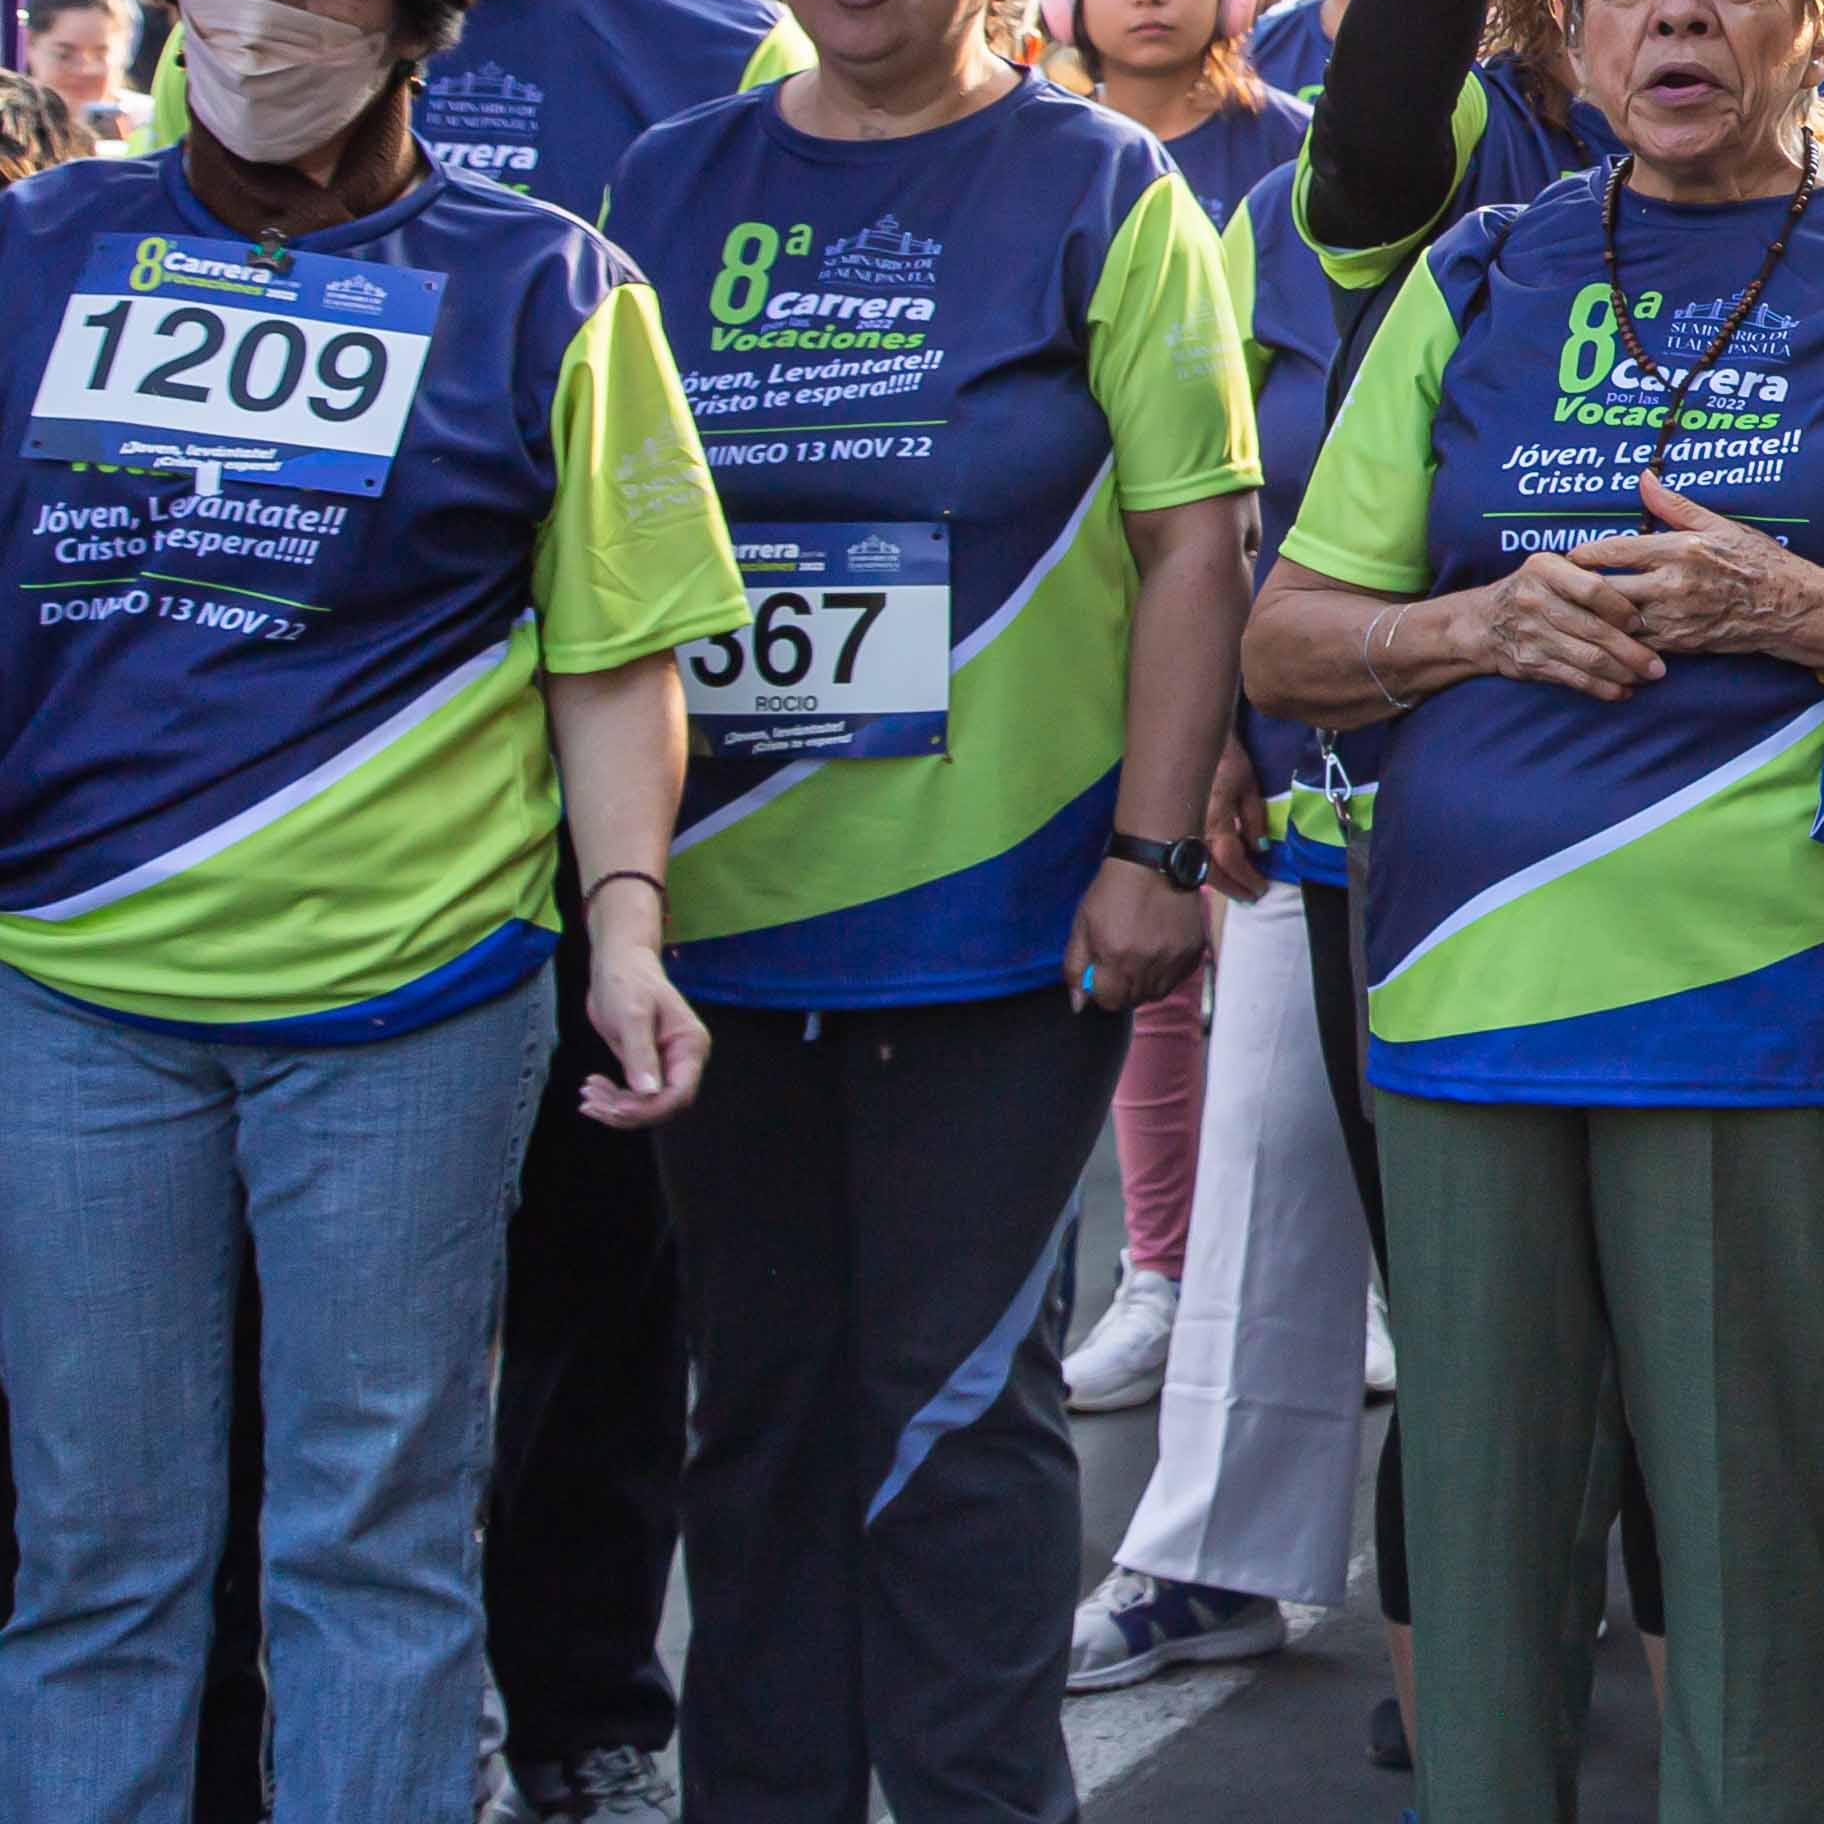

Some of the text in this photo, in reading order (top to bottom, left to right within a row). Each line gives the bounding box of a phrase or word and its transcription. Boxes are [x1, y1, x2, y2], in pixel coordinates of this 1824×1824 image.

[164, 252, 272, 283] Carrera
[766, 292, 936, 321] Carrera
[709, 324, 927, 352] Vocaciones
[81, 300, 390, 423] 1209
[767, 350, 945, 385] Levántate!!
[762, 372, 923, 409] te espera!!!!
[1610, 358, 1790, 403] Carrera
[1553, 396, 1782, 431] Vocaciones
[1606, 391, 1746, 412] por las 2022
[796, 442, 824, 462] 13
[830, 438, 894, 460] NOV
[896, 437, 933, 458] 22
[1502, 444, 1606, 471] Jóven,
[1517, 470, 1604, 496] Cristo
[1610, 474, 1639, 492] te
[32, 502, 140, 535] Jóven,
[54, 534, 147, 564] Cristo
[159, 595, 306, 641] 13 NOV 22
[689, 592, 888, 687] 367
[755, 695, 819, 712] ROCIO
